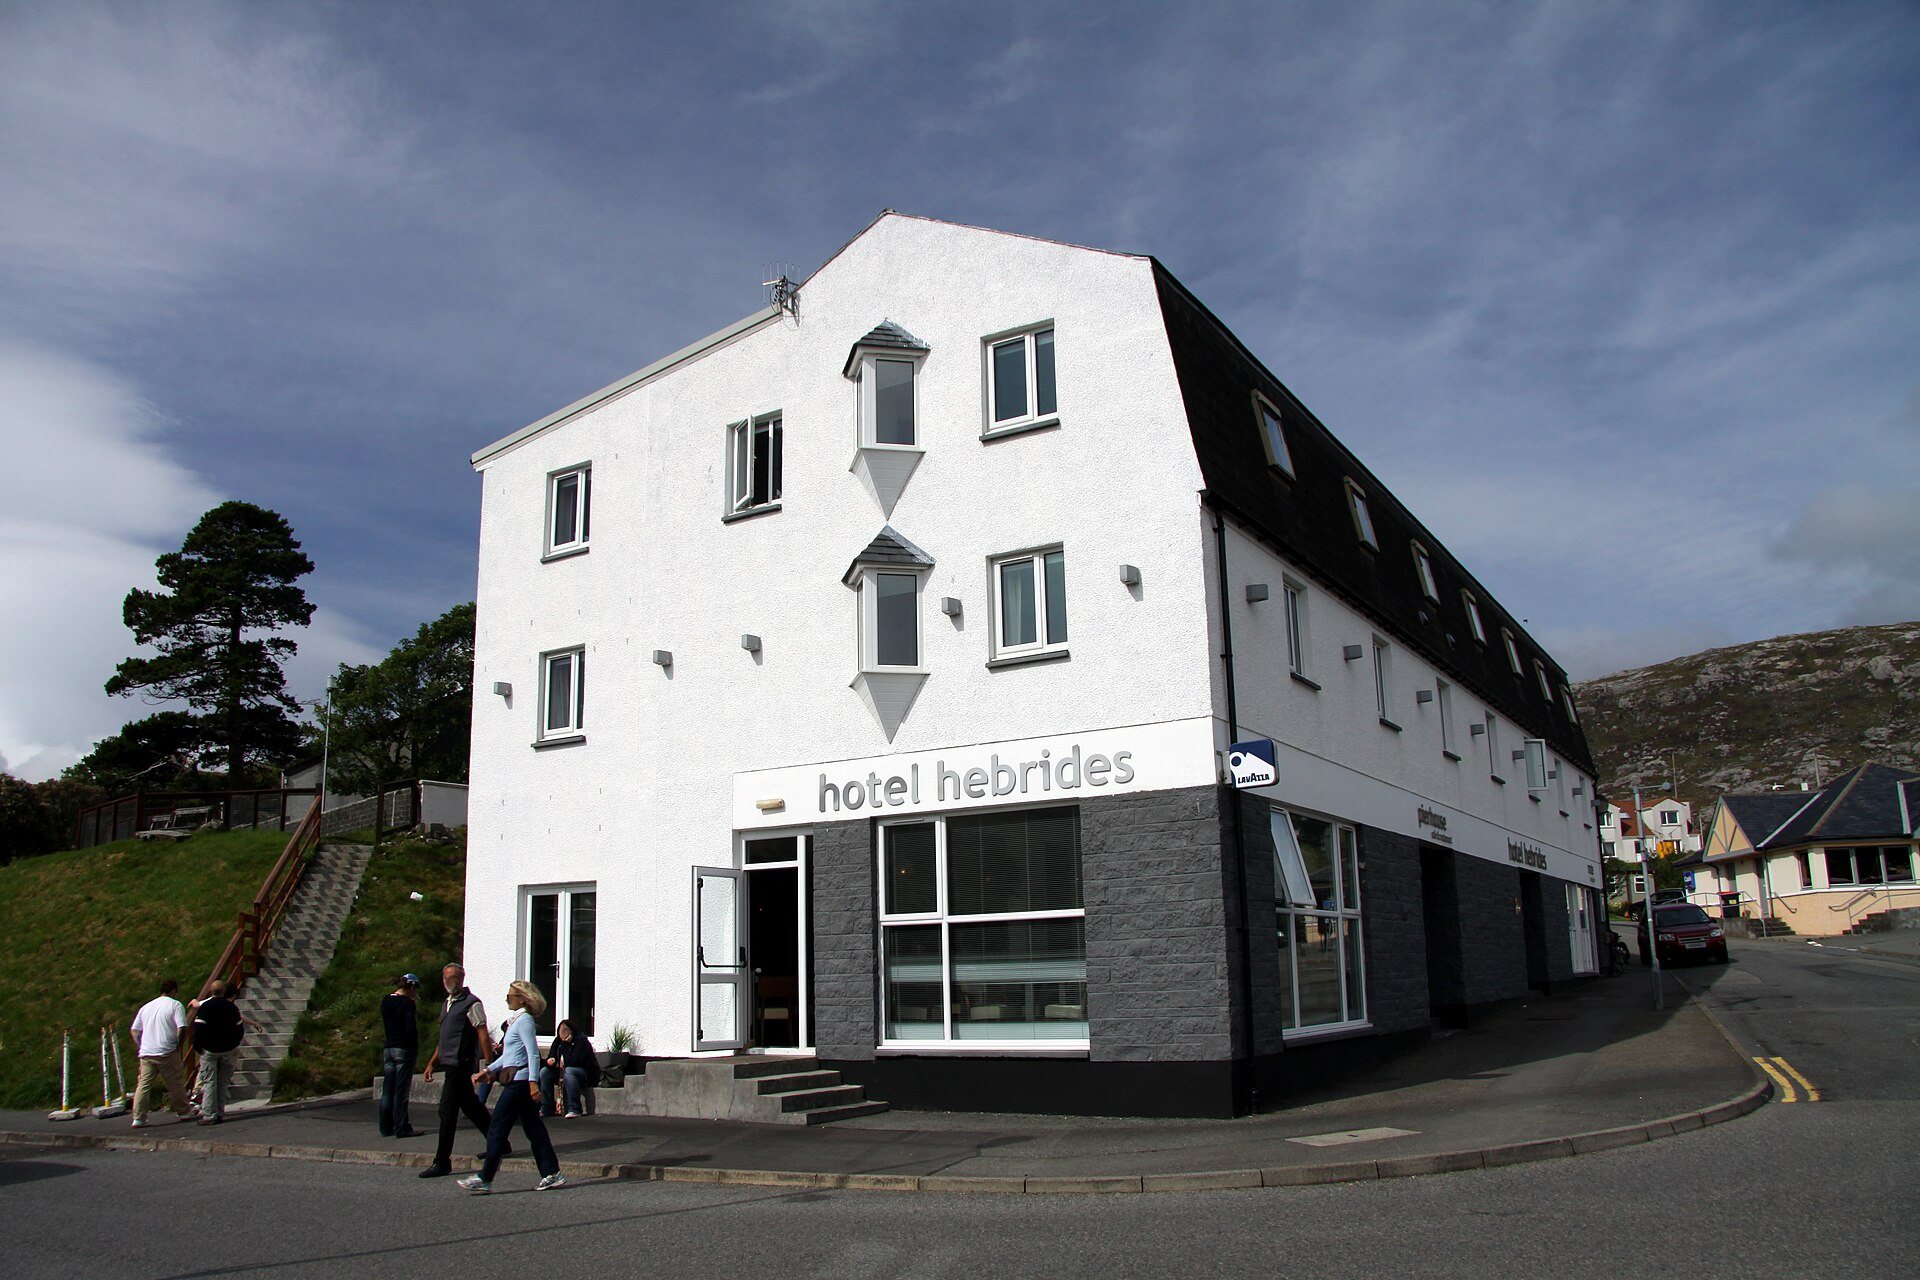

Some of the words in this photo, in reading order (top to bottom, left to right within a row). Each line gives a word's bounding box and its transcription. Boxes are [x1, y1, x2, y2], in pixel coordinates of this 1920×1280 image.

[819, 763, 920, 812] hotel
[938, 745, 1135, 801] hebrides
[1238, 773, 1270, 784] LAVAZZA
[1507, 837, 1523, 863] hotel
[1523, 842, 1547, 870] hebrides
